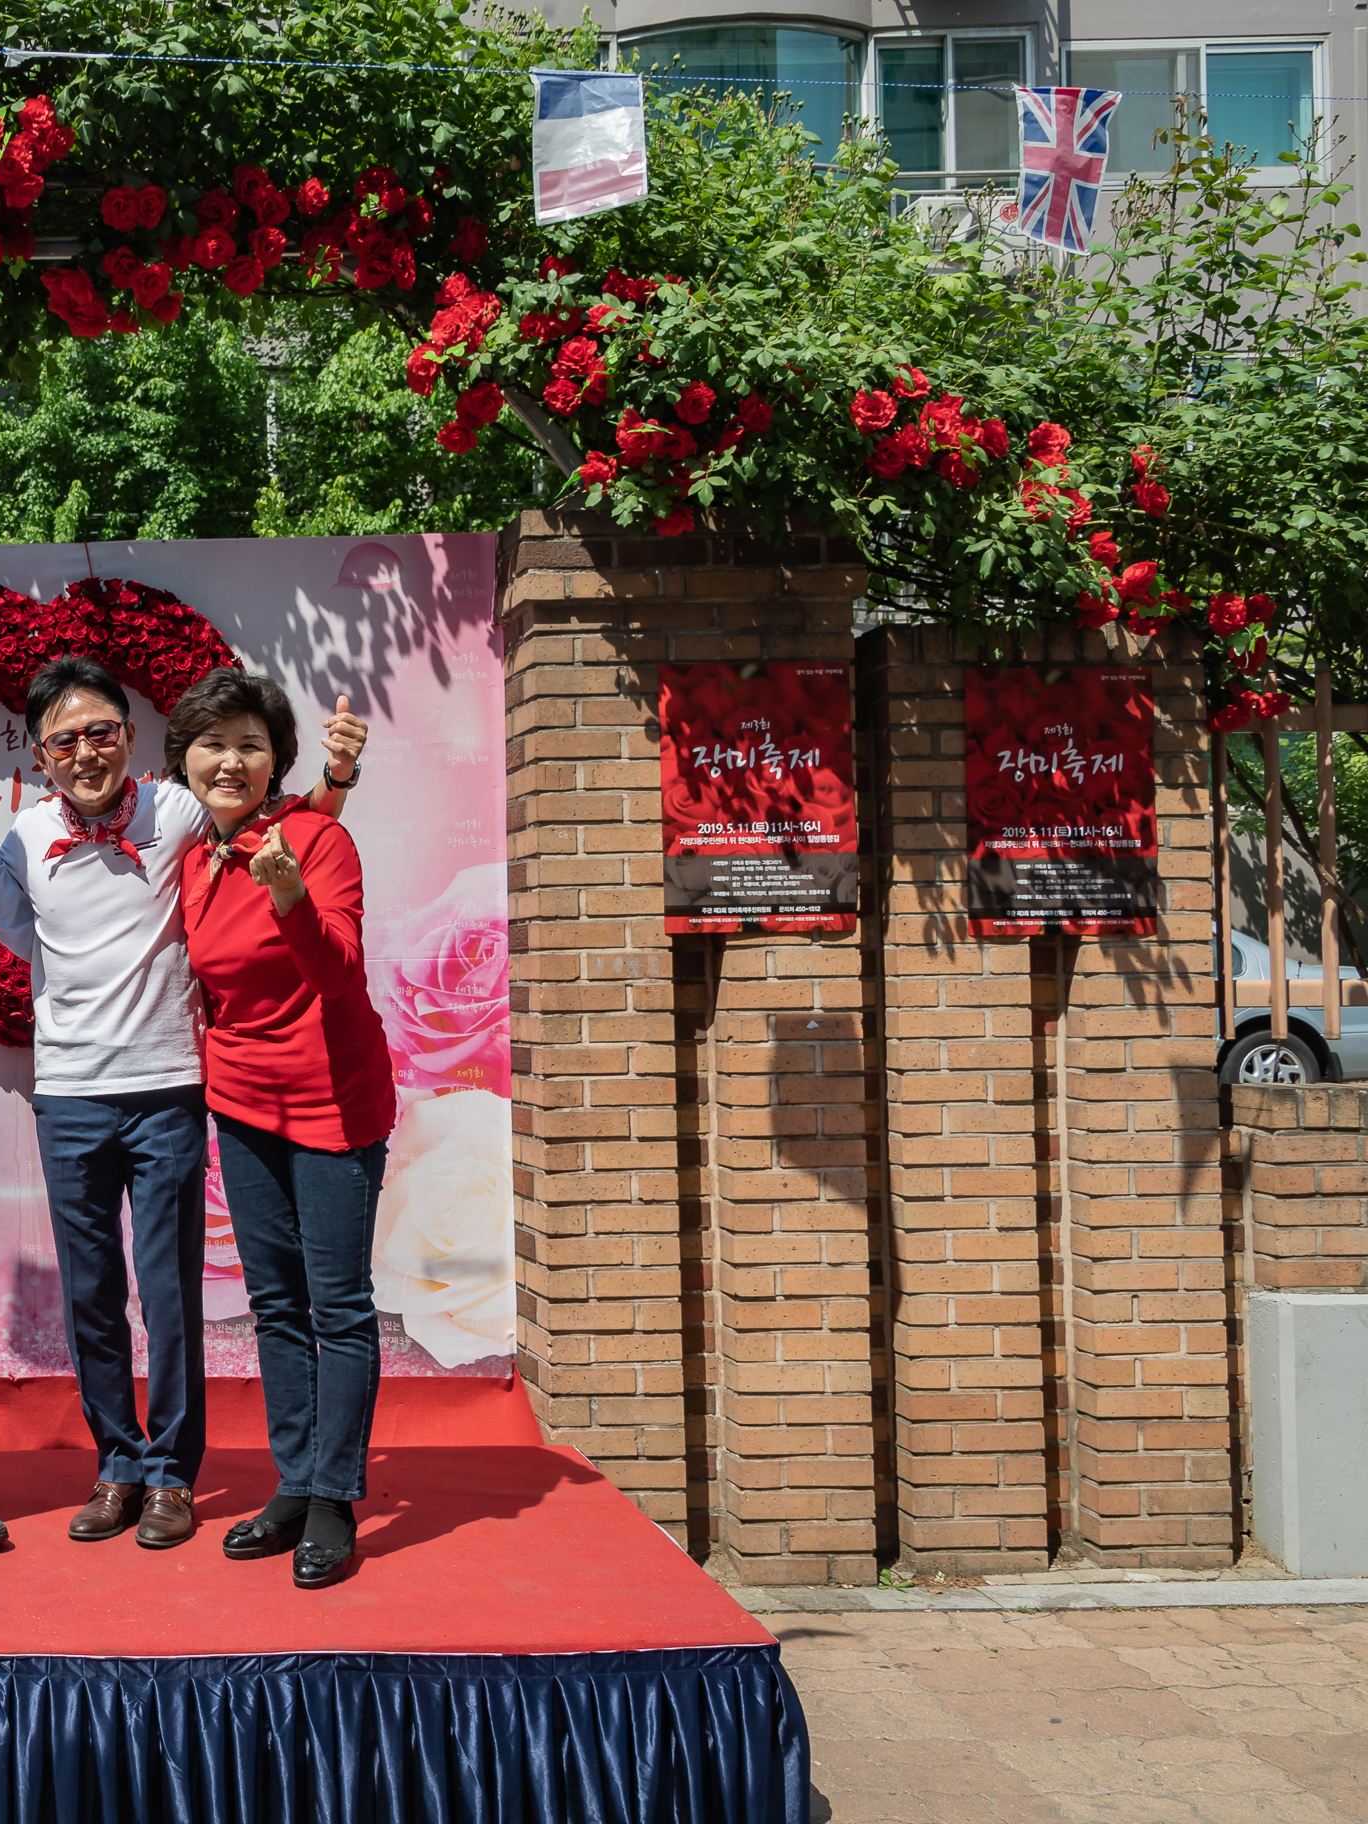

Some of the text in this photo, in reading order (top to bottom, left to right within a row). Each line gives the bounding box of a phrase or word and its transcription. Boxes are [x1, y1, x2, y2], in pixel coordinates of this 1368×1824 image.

[741, 718, 770, 731] 제3회
[1044, 723, 1073, 736] 제3회
[692, 733, 820, 779] 장미축제
[997, 738, 1123, 784] 장미축제
[771, 820, 821, 832] 11시~16시
[1073, 825, 1123, 837] 11시~16시
